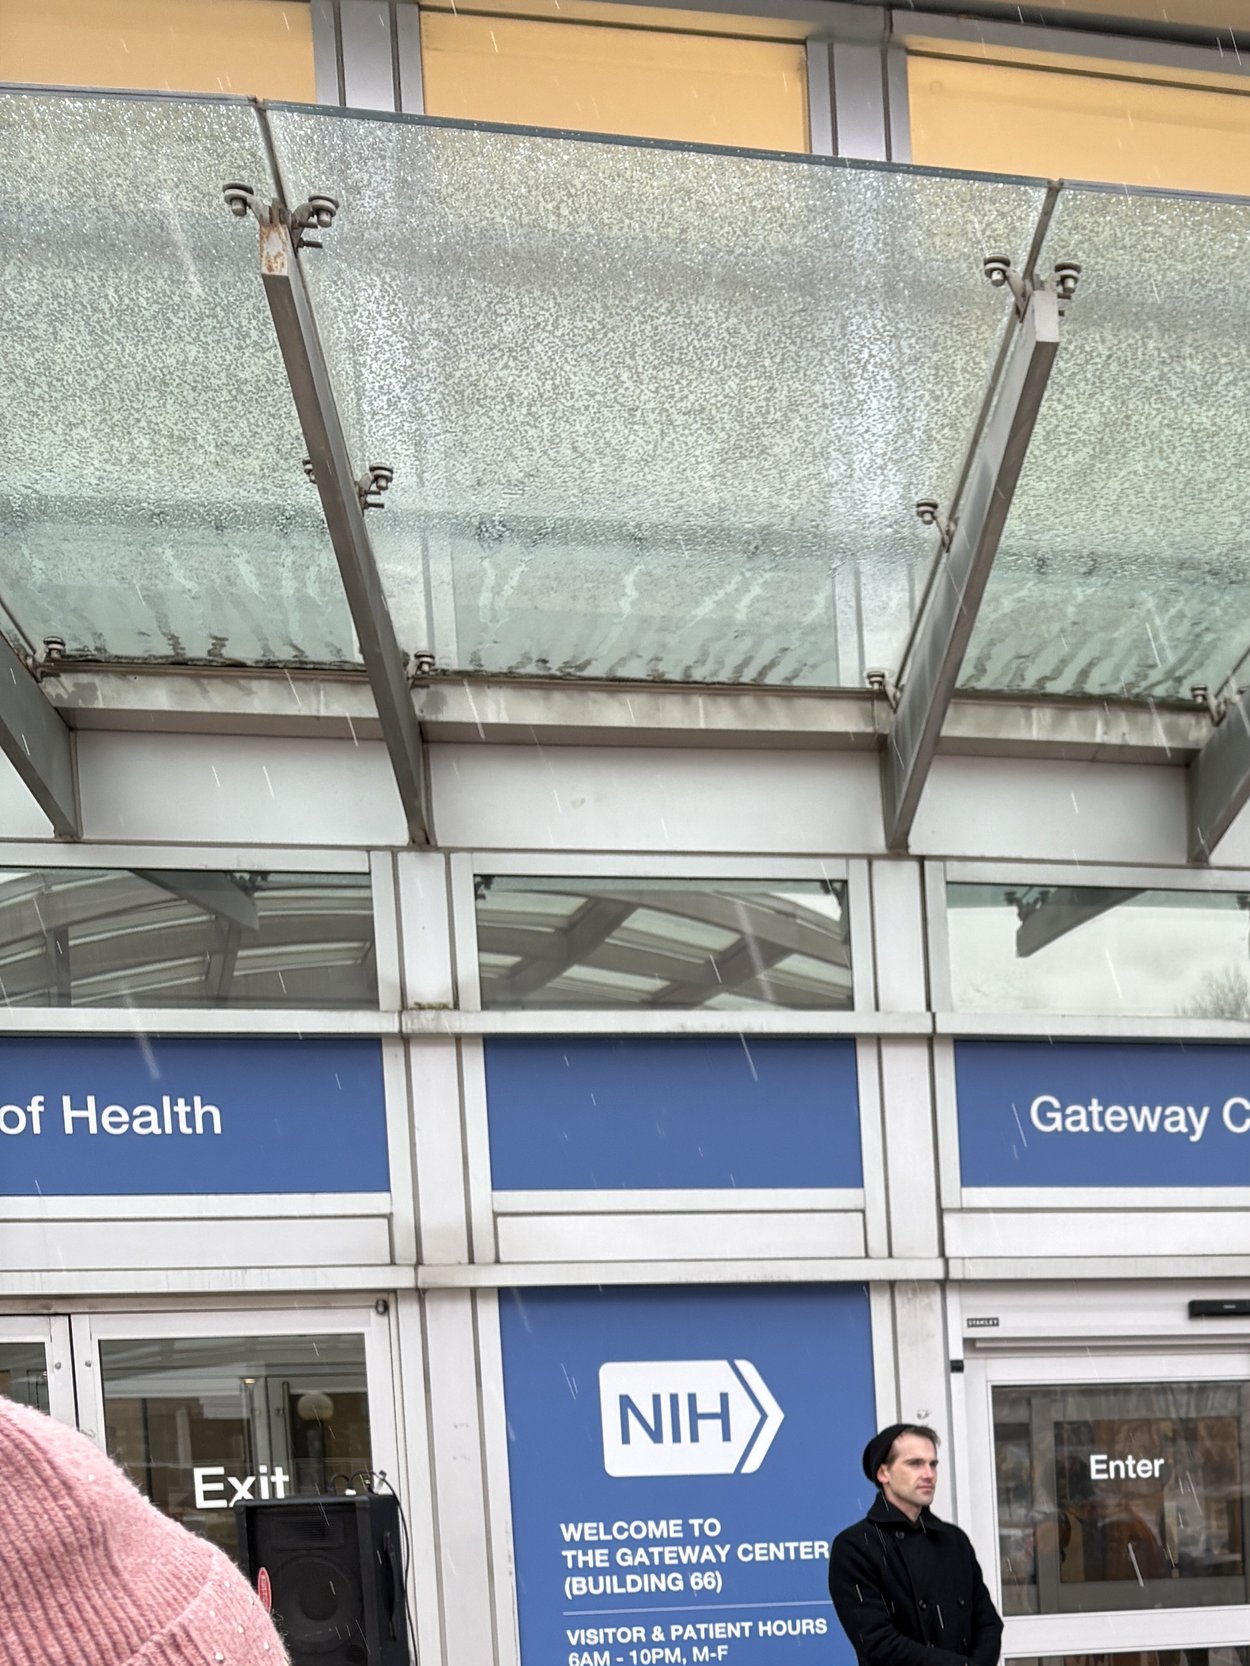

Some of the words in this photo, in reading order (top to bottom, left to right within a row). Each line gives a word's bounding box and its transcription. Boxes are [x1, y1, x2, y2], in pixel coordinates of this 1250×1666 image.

[0, 1095, 45, 1135] of
[62, 1095, 222, 1135] Health
[1031, 1095, 1209, 1142] Gateway
[619, 1392, 732, 1445] NIH
[1090, 1453, 1165, 1480] Enter
[193, 1465, 290, 1509] Exit
[560, 1520, 683, 1541] WELCOME
[689, 1518, 721, 1537] TO
[562, 1549, 609, 1568] THE
[616, 1544, 730, 1566] GATEWAY
[737, 1541, 829, 1562] CENTER
[565, 1573, 683, 1599] (BUILDING
[690, 1571, 722, 1593] 66)
[567, 1627, 646, 1645] VISITOR
[652, 1626, 665, 1641] &
[671, 1622, 752, 1640] PATIENT
[759, 1618, 827, 1636] HOURS
[630, 1648, 686, 1665] 10PM,
[693, 1645, 728, 1662] M-F
